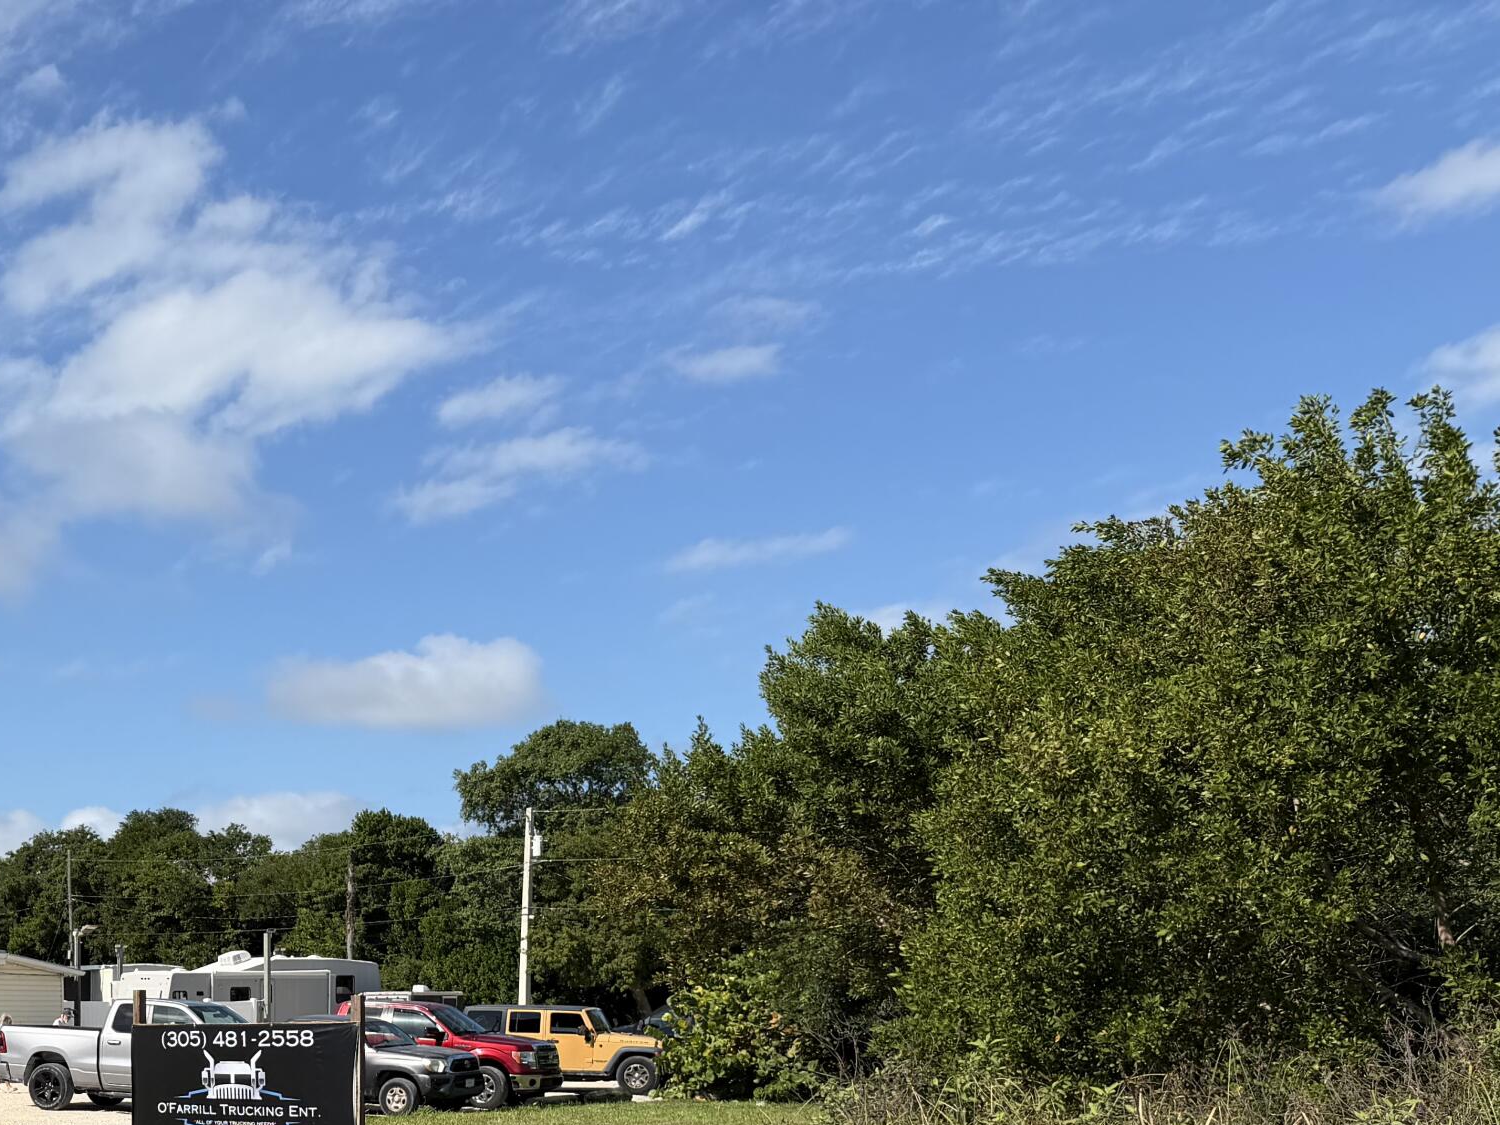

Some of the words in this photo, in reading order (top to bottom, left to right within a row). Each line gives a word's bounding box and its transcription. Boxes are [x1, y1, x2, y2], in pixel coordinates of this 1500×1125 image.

[161, 1030, 207, 1050] (305)
[213, 1029, 314, 1047] 481-2558
[220, 1103, 284, 1117] TRUCKING
[289, 1105, 323, 1118] ENT.
